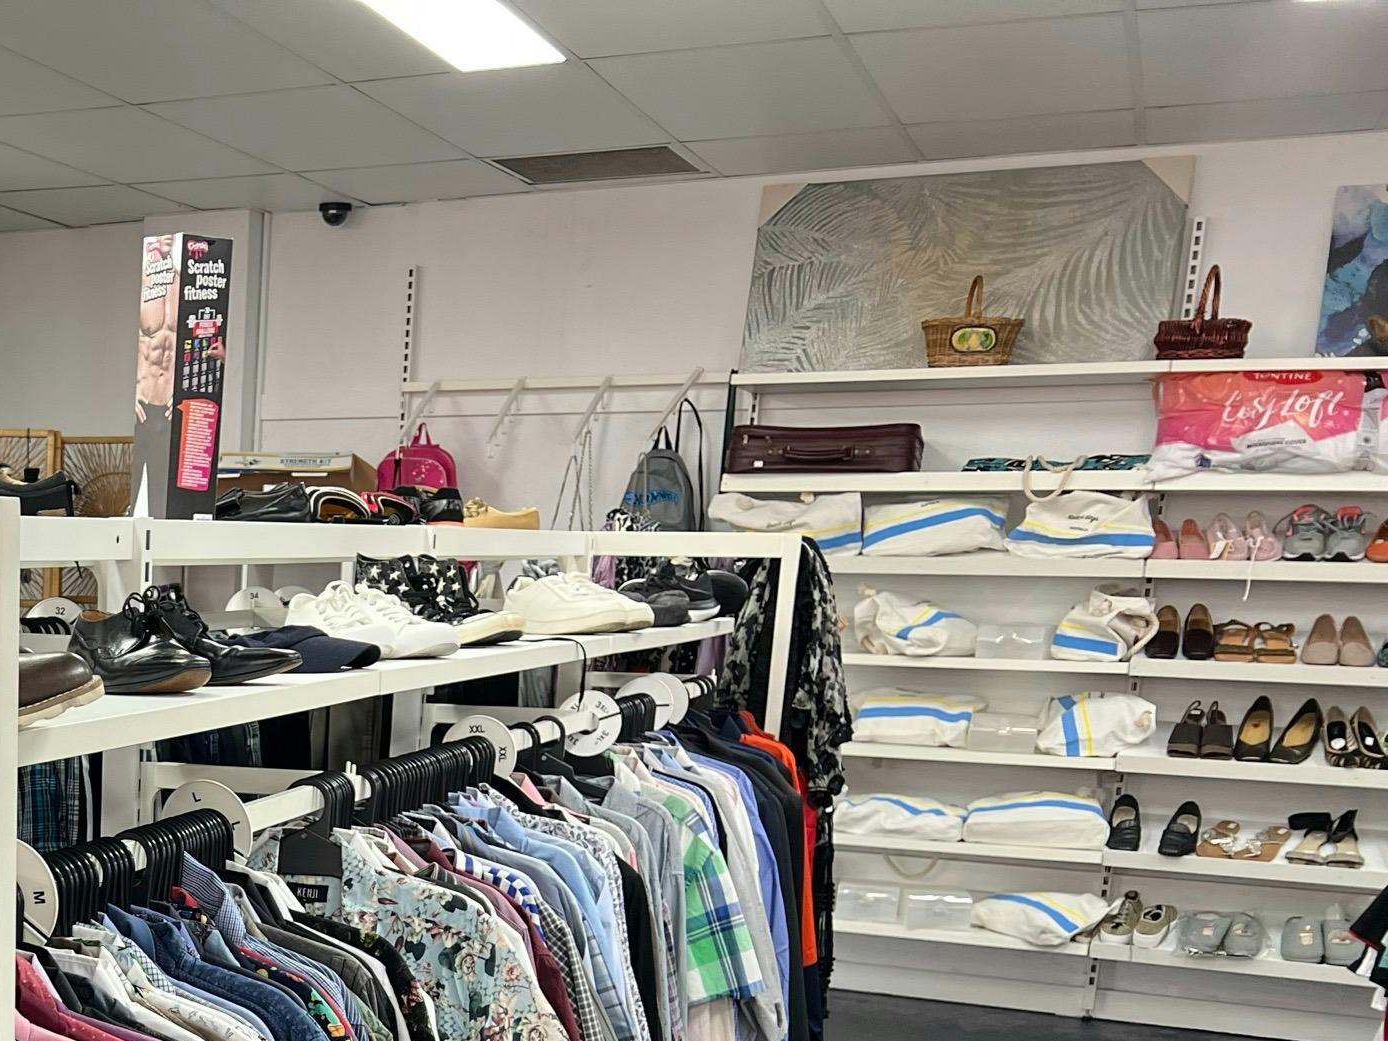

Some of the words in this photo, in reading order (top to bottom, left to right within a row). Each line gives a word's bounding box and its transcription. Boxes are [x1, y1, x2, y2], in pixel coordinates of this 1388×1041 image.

[187, 259, 224, 274] Scratch
[196, 274, 227, 288] poster
[184, 285, 218, 300] fitness
[55, 607, 65, 616] 32
[469, 725, 486, 733] XXL
[498, 746, 507, 763] XXL
[192, 791, 202, 803] L
[32, 891, 46, 905] M
[297, 887, 319, 898] KENJI
